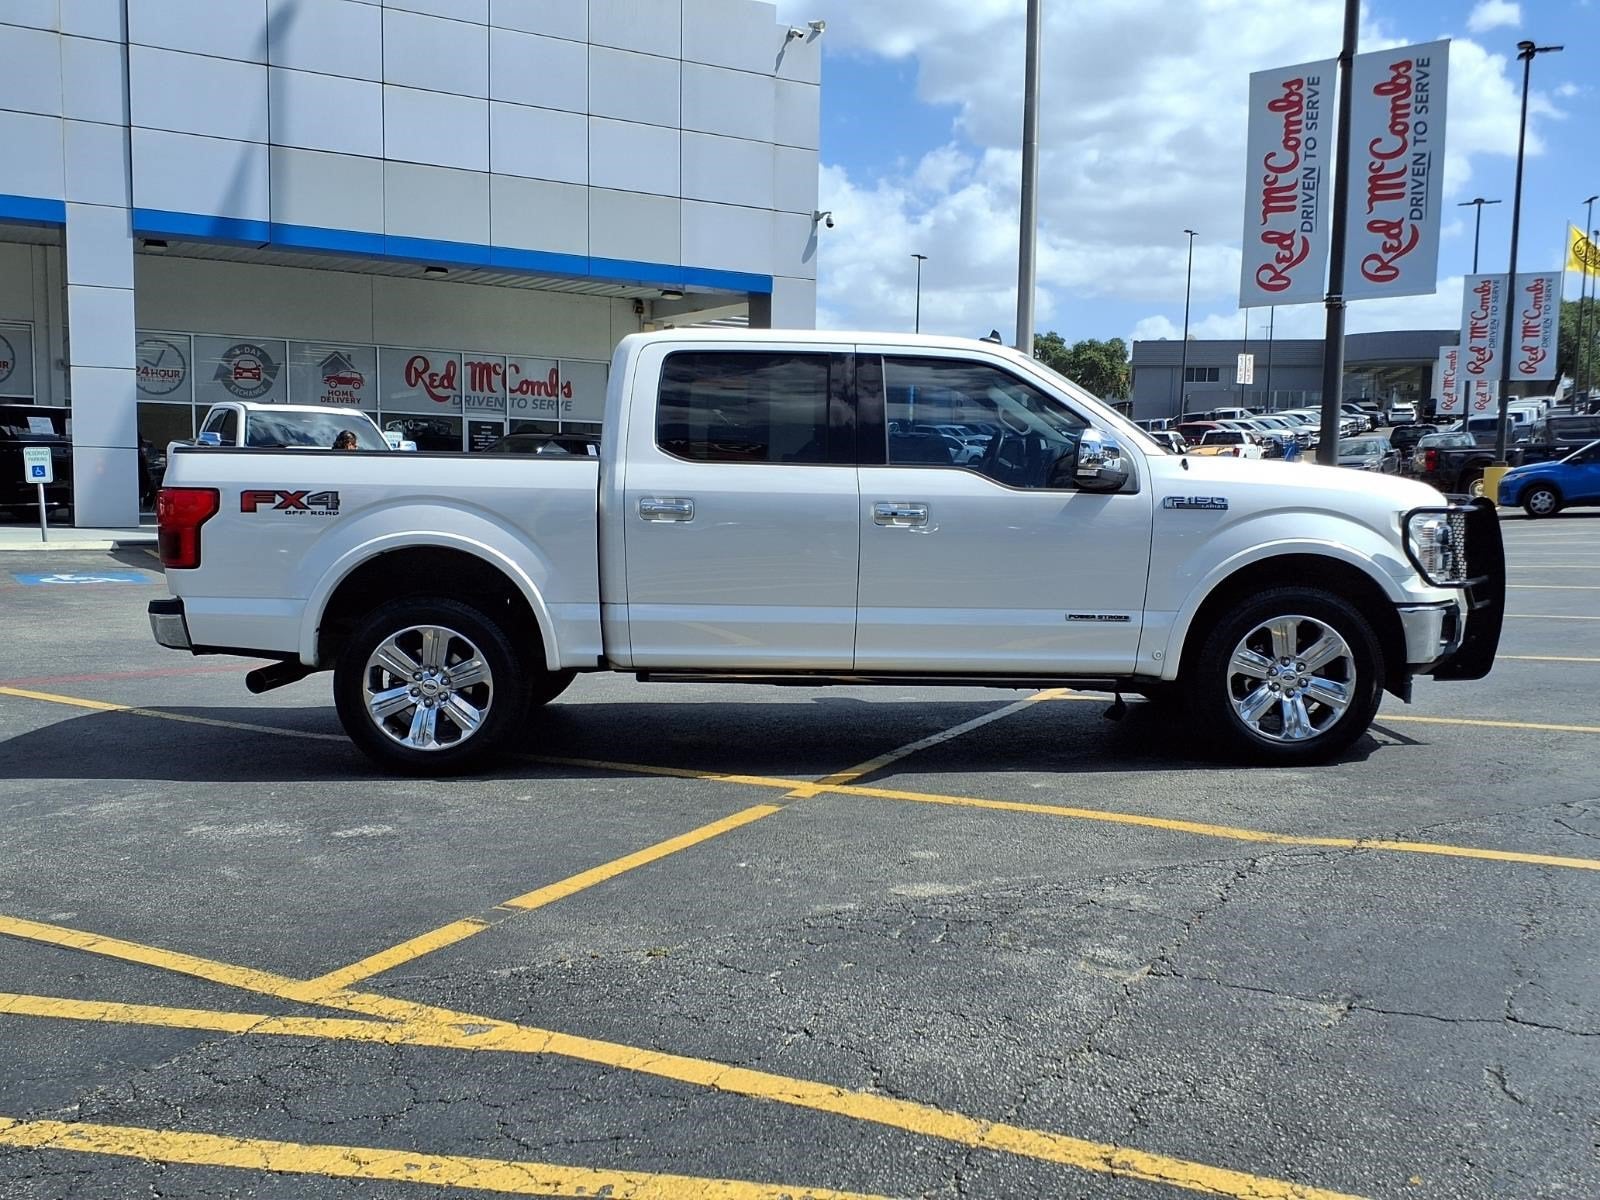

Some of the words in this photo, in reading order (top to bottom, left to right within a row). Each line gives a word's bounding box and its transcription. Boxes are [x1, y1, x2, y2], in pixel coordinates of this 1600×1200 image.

[1415, 56, 1431, 114] SERVE
[1305, 76, 1320, 131] SERVE
[1366, 60, 1413, 215] McCombs
[1413, 120, 1428, 146] TO
[1260, 78, 1304, 226] McCombs
[1304, 137, 1317, 162] TO
[1300, 166, 1316, 233] DRIVEN
[1409, 153, 1426, 221] DRIVEN
[1256, 229, 1310, 292] Red
[1361, 217, 1419, 283] Red
[1492, 280, 1500, 303] SERVE
[1544, 278, 1553, 302] SERVE
[1469, 280, 1491, 344] McCombs
[1490, 305, 1498, 316] TO
[1522, 278, 1544, 343] McCombs
[1543, 304, 1552, 316] TO
[1489, 319, 1497, 349] DRIVEN
[1541, 318, 1550, 348] DRIVEN
[1466, 346, 1494, 374] Red
[1518, 345, 1546, 374] Red
[405, 355, 457, 402] Red
[465, 361, 573, 398] McCombs
[320, 396, 361, 404] DELIVERY
[452, 394, 507, 409] DRIVEN
[508, 398, 527, 409] TO
[531, 400, 573, 411] SERVE
[1440, 391, 1458, 410] Red
[1474, 391, 1491, 410] Red
[240, 490, 340, 512] FX4
